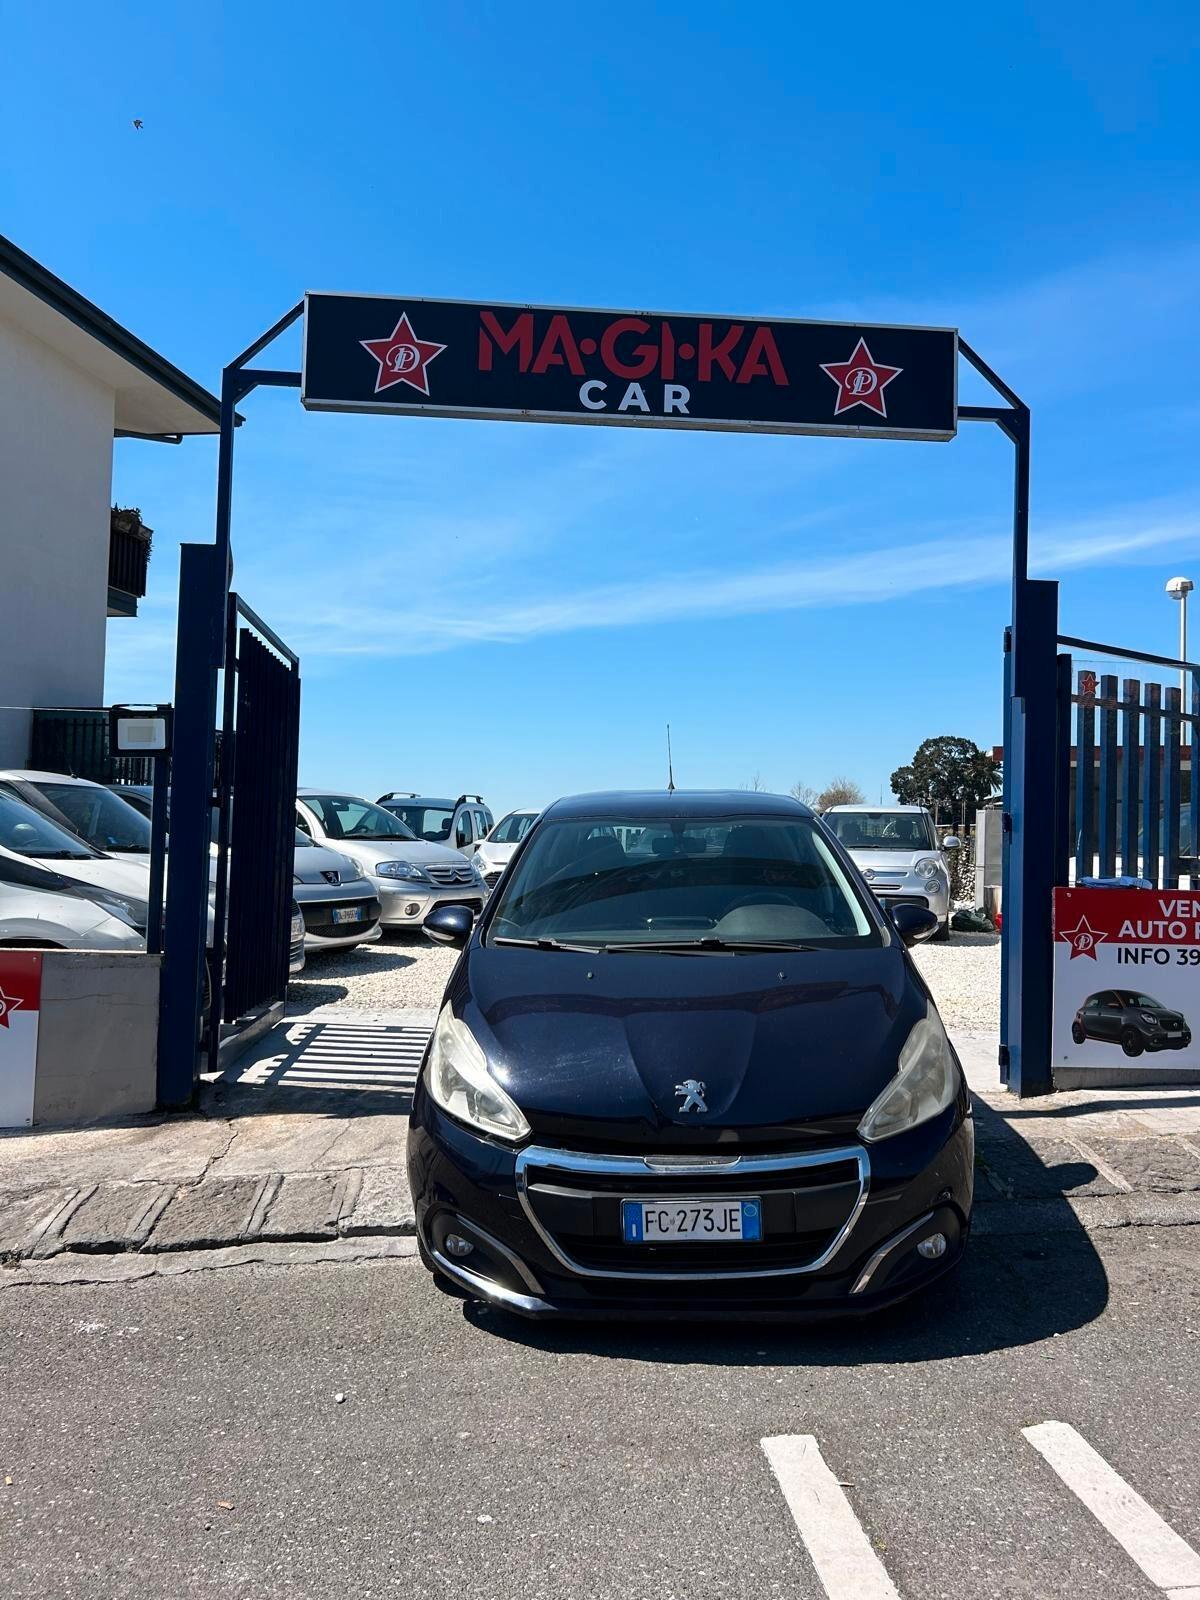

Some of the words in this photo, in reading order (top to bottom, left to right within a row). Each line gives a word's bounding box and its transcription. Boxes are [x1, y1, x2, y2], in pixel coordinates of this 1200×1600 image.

[579, 379, 690, 414] CAR
[1117, 920, 1187, 939] AUTO
[1117, 947, 1170, 965] INFO
